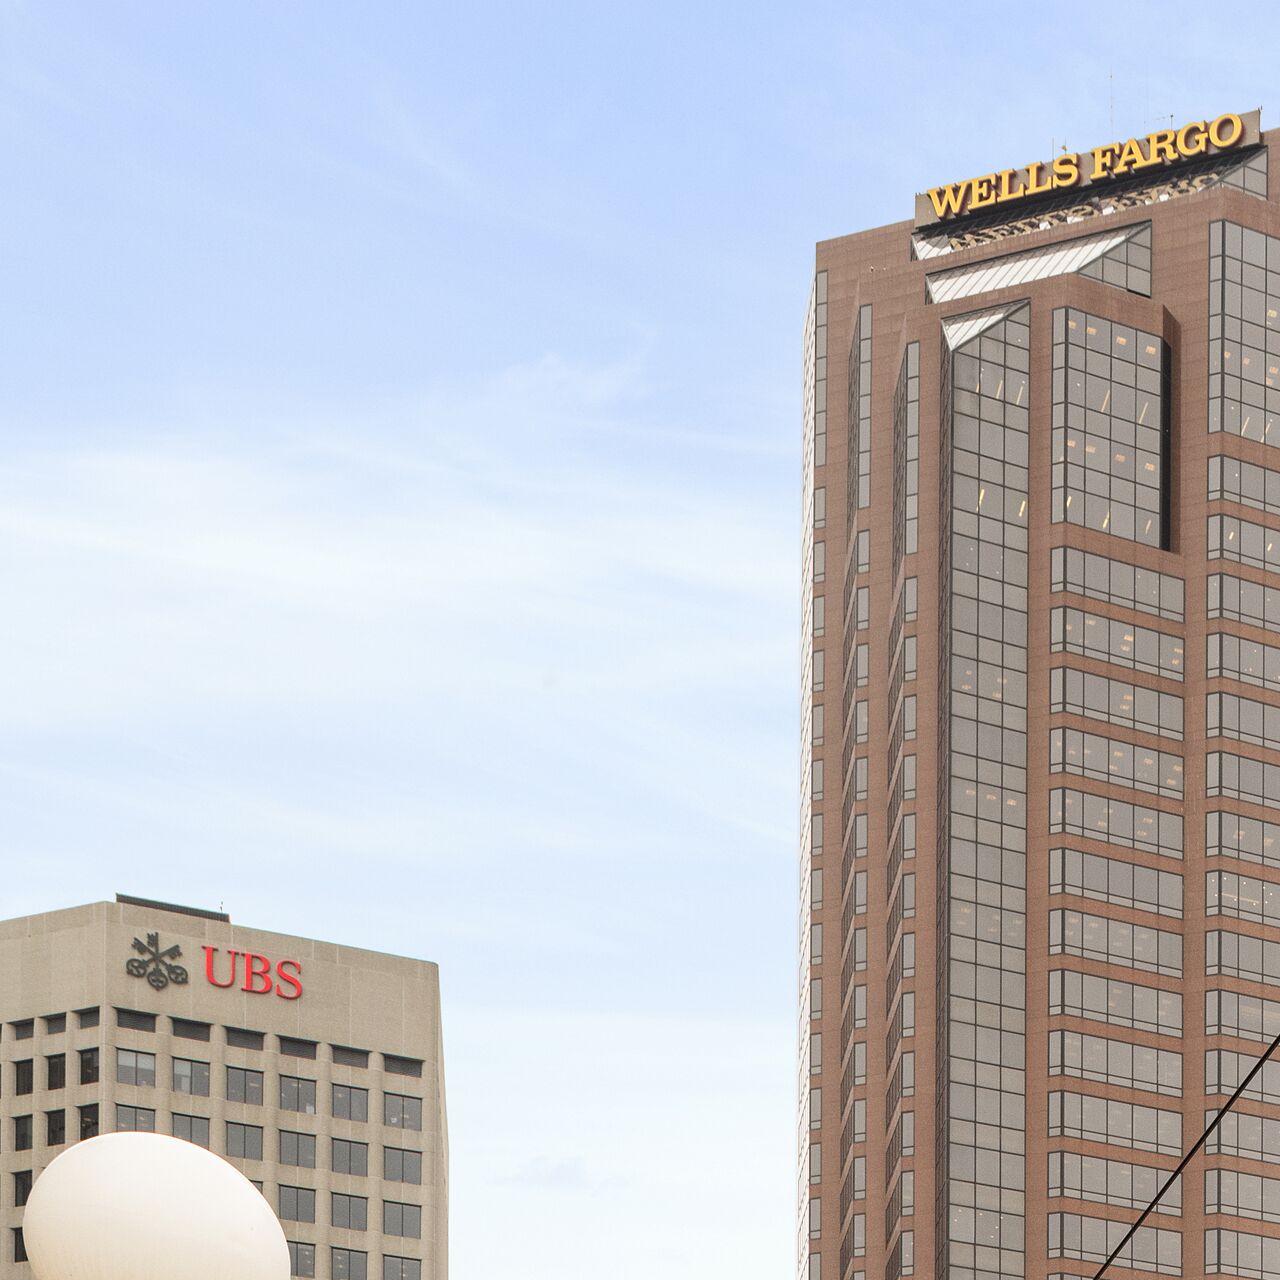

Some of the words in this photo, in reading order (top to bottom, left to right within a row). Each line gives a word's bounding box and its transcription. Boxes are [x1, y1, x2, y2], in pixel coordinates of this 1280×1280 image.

[928, 153, 1081, 218] WELLS
[1090, 113, 1245, 180] FARGO
[201, 945, 303, 1000] UBS
